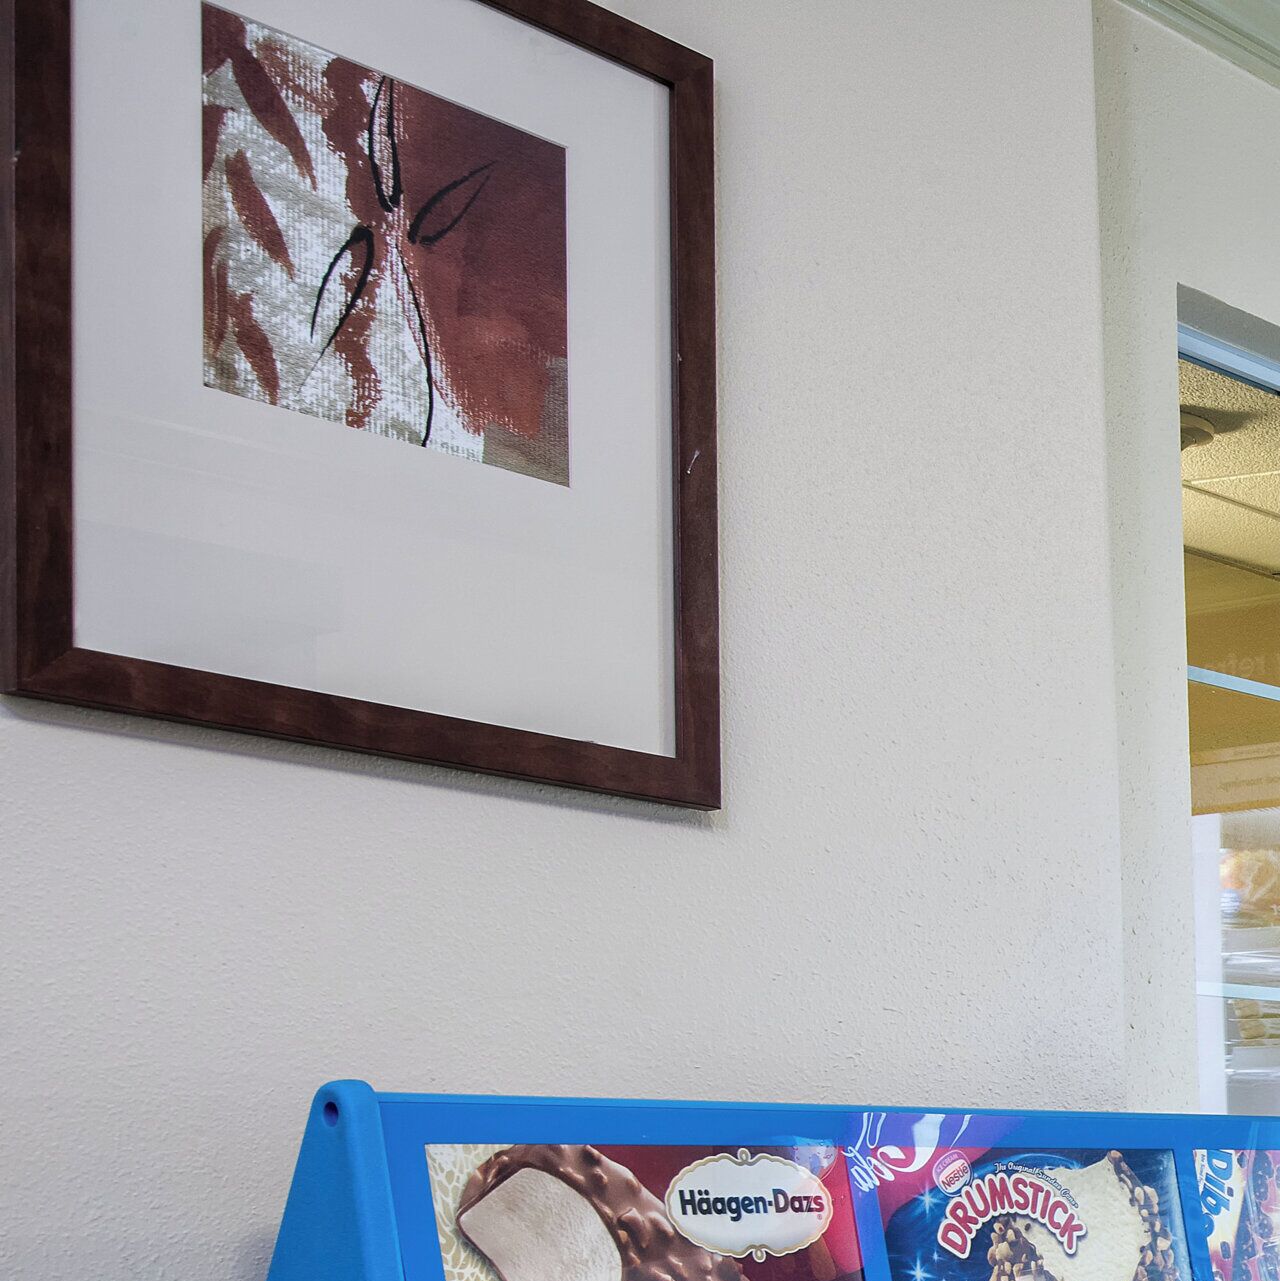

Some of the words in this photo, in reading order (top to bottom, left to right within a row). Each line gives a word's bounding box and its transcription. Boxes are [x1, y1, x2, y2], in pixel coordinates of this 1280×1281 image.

[942, 1163, 969, 1189] Nestlé
[678, 1188, 825, 1221] Häagen-Dazs
[940, 1176, 1085, 1257] DRUMSTICK
